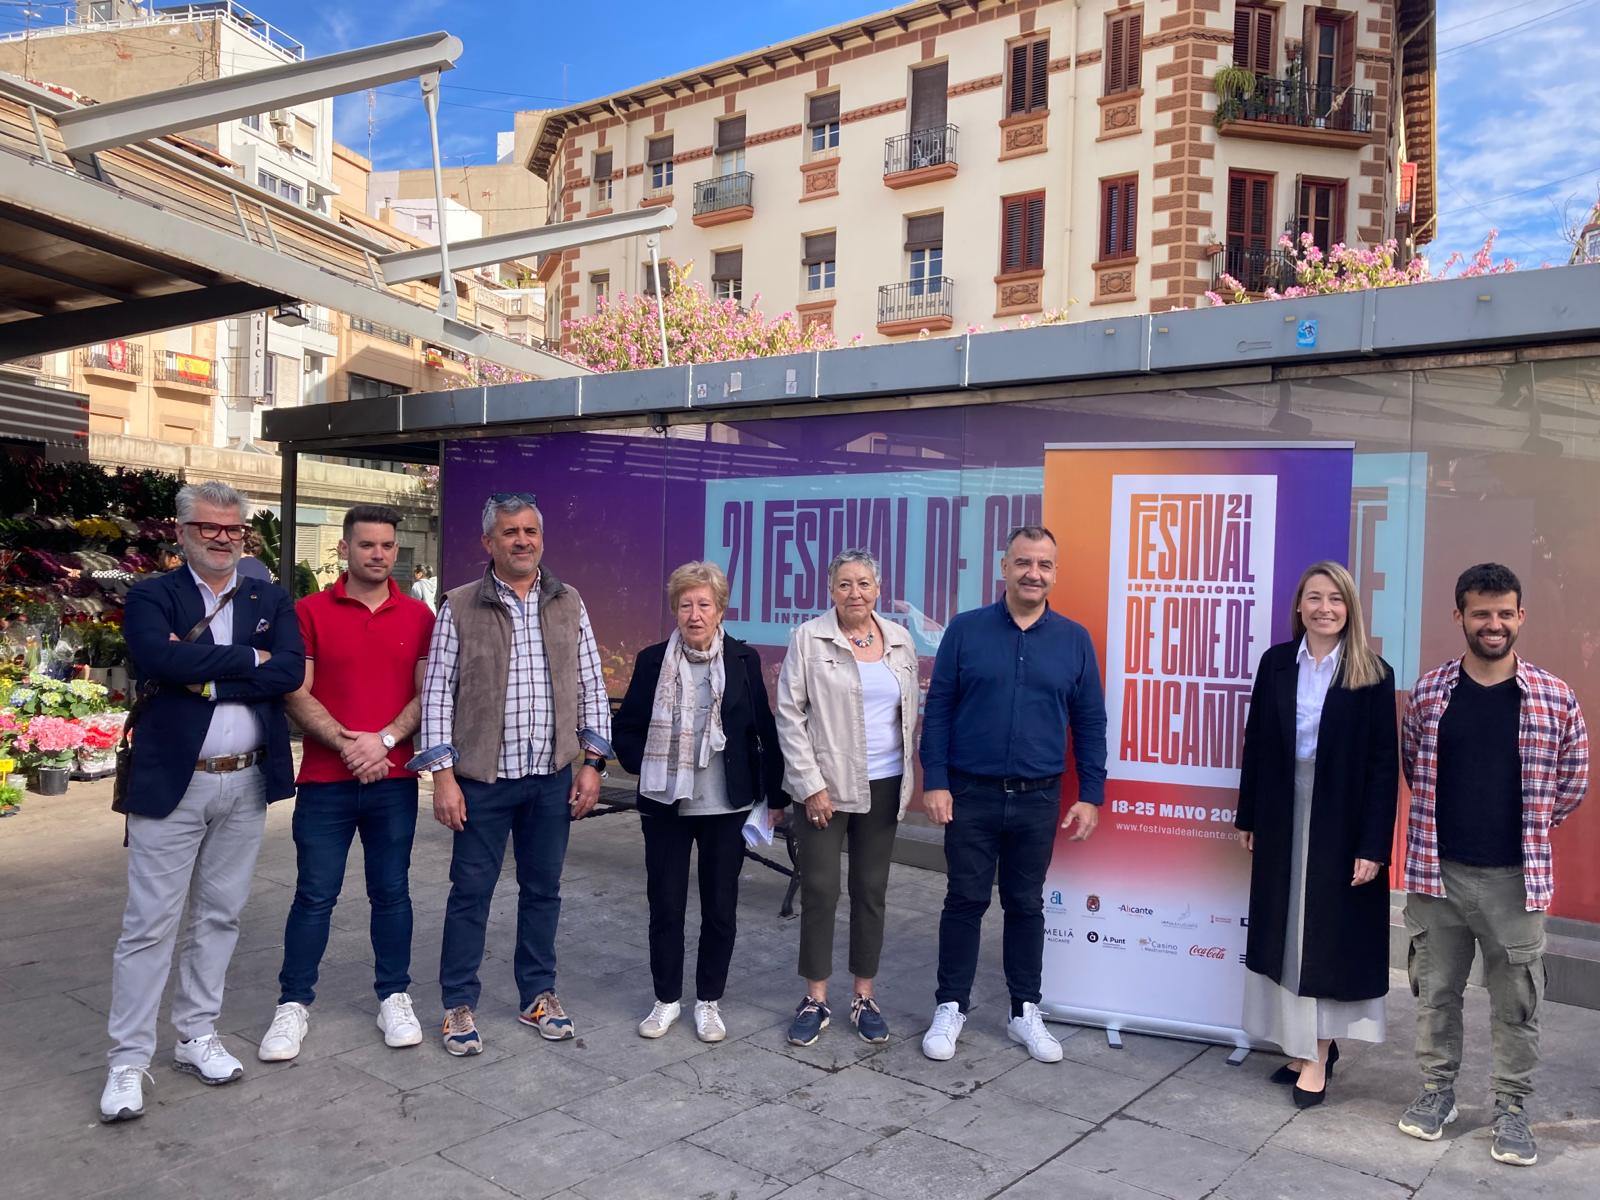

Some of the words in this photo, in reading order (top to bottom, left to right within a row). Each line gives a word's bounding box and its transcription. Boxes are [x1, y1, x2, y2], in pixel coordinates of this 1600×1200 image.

[1128, 493, 1255, 583] FESTIVAL
[1127, 583, 1255, 595] INTERNACIONAL
[1124, 596, 1157, 675] DE
[1161, 597, 1222, 678] CINE
[1224, 599, 1256, 680] DE
[1111, 800, 1155, 816] 18-25
[1116, 823, 1240, 840] www.festivaldealicante.co
[1119, 904, 1154, 915] Alicante
[1110, 936, 1126, 944] Punt
[1151, 940, 1178, 951] Casino
